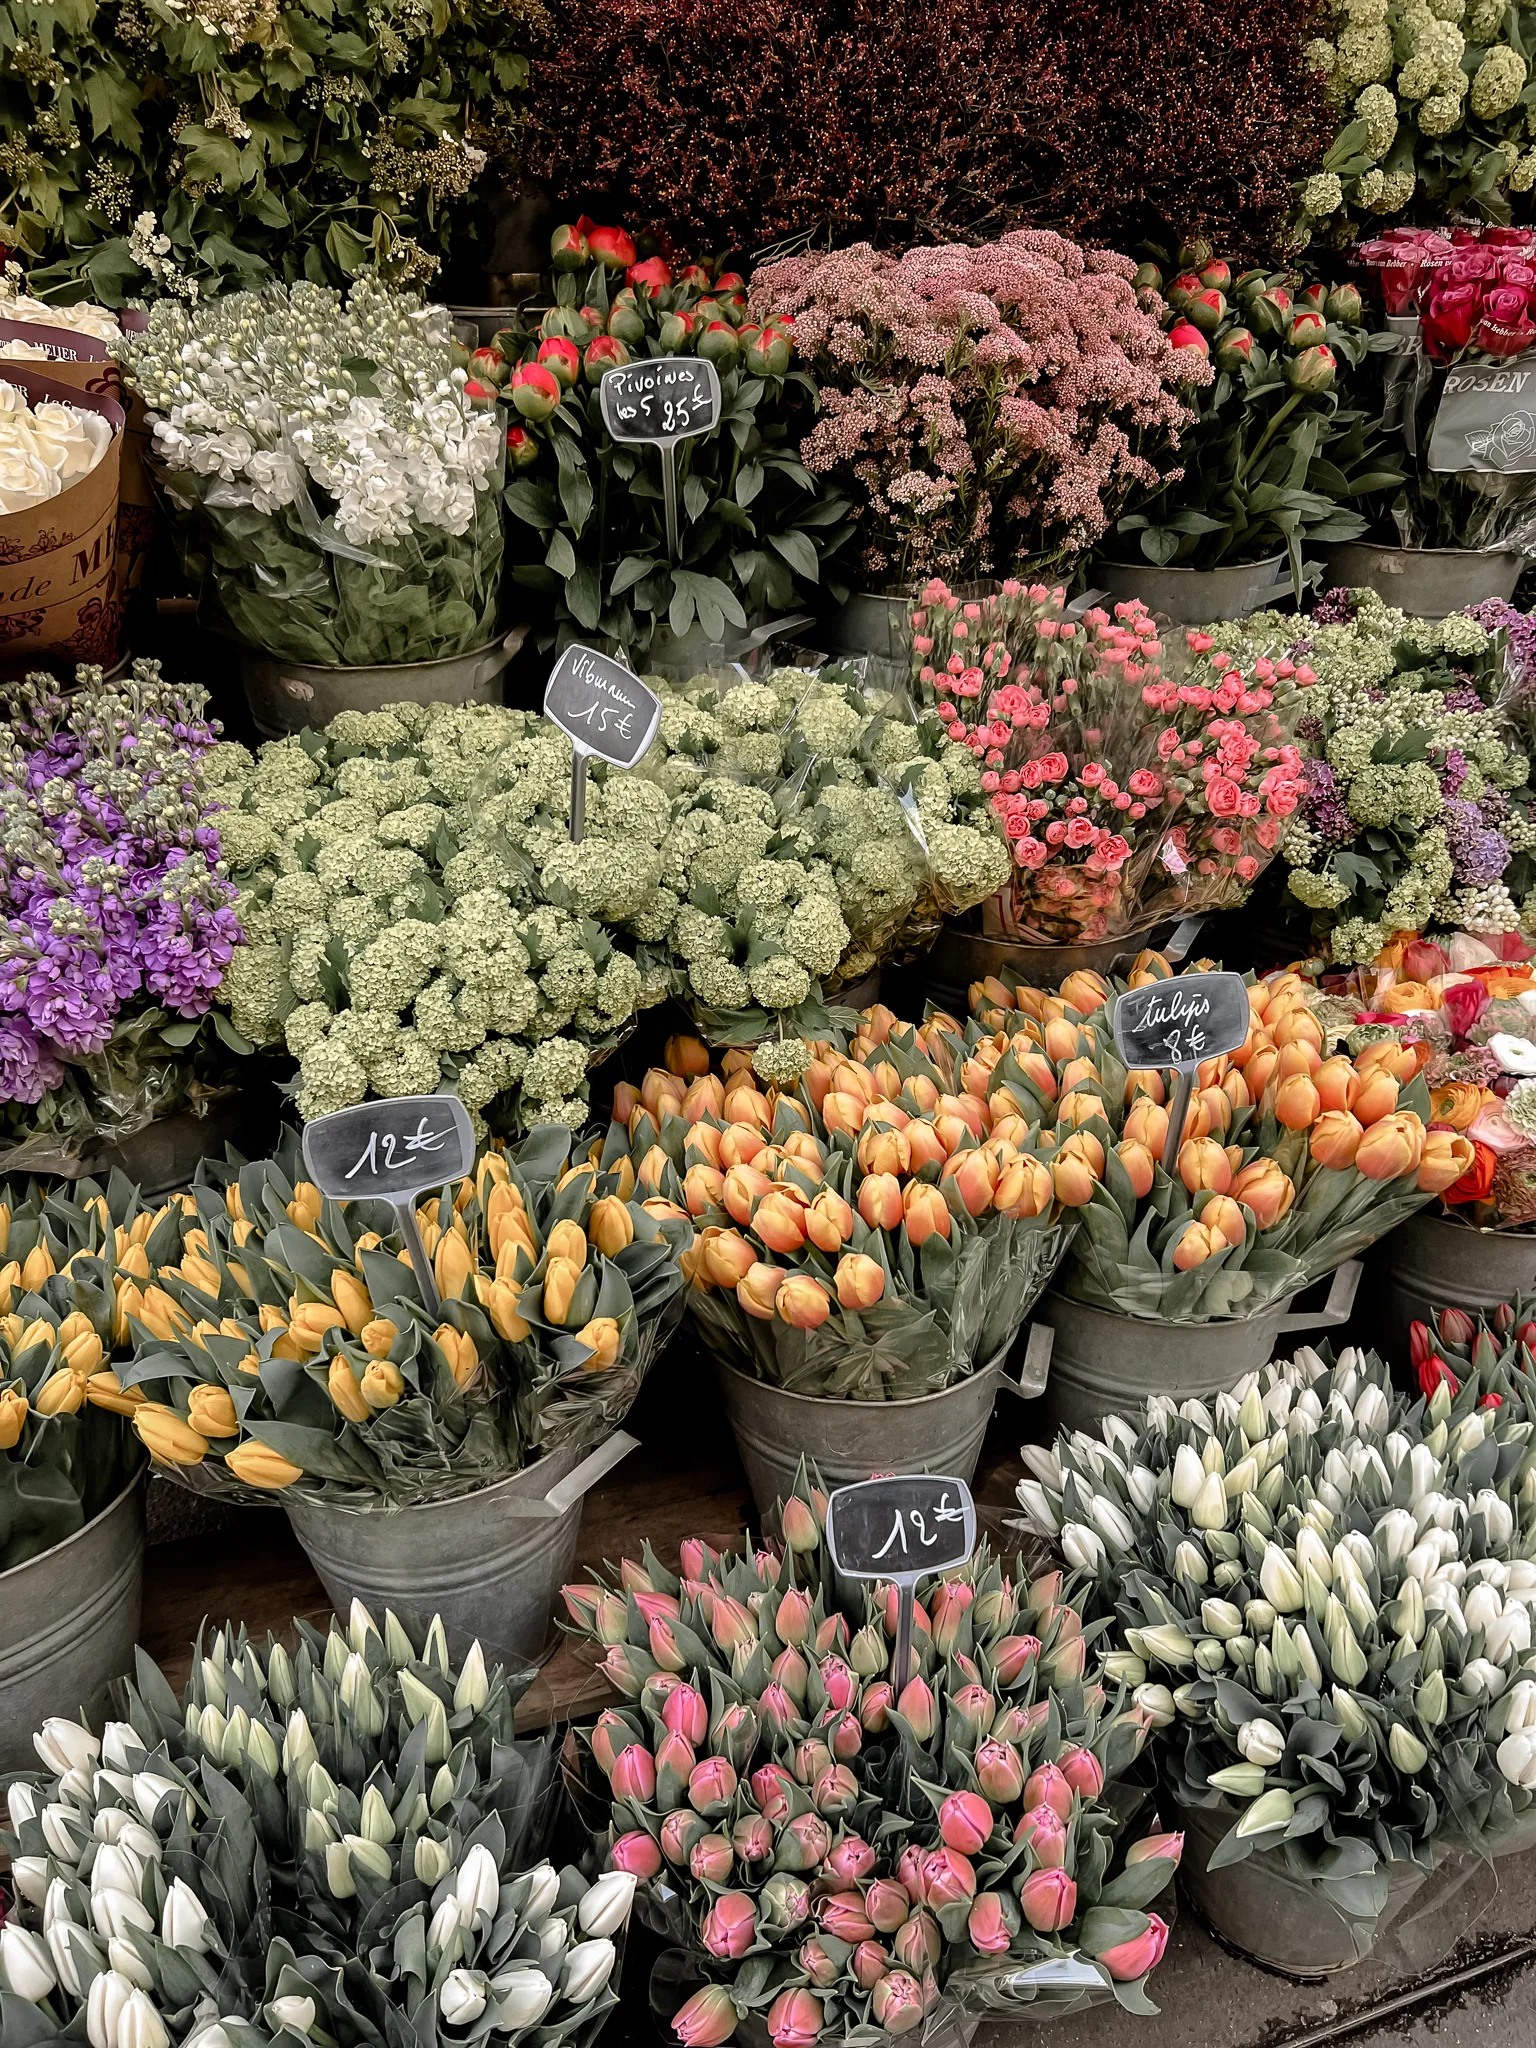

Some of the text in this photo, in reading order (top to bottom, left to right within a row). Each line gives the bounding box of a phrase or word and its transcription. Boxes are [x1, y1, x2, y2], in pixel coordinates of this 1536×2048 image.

[1386, 259, 1408, 268] Bebber
[1420, 259, 1443, 268] Rosen
[1491, 323, 1517, 337] Bebber
[608, 365, 695, 396] Pivoines
[1443, 371, 1532, 395] ROSEN
[567, 701, 634, 740] 15€
[344, 1117, 460, 1179] 12€
[871, 1492, 971, 1560] 12€
